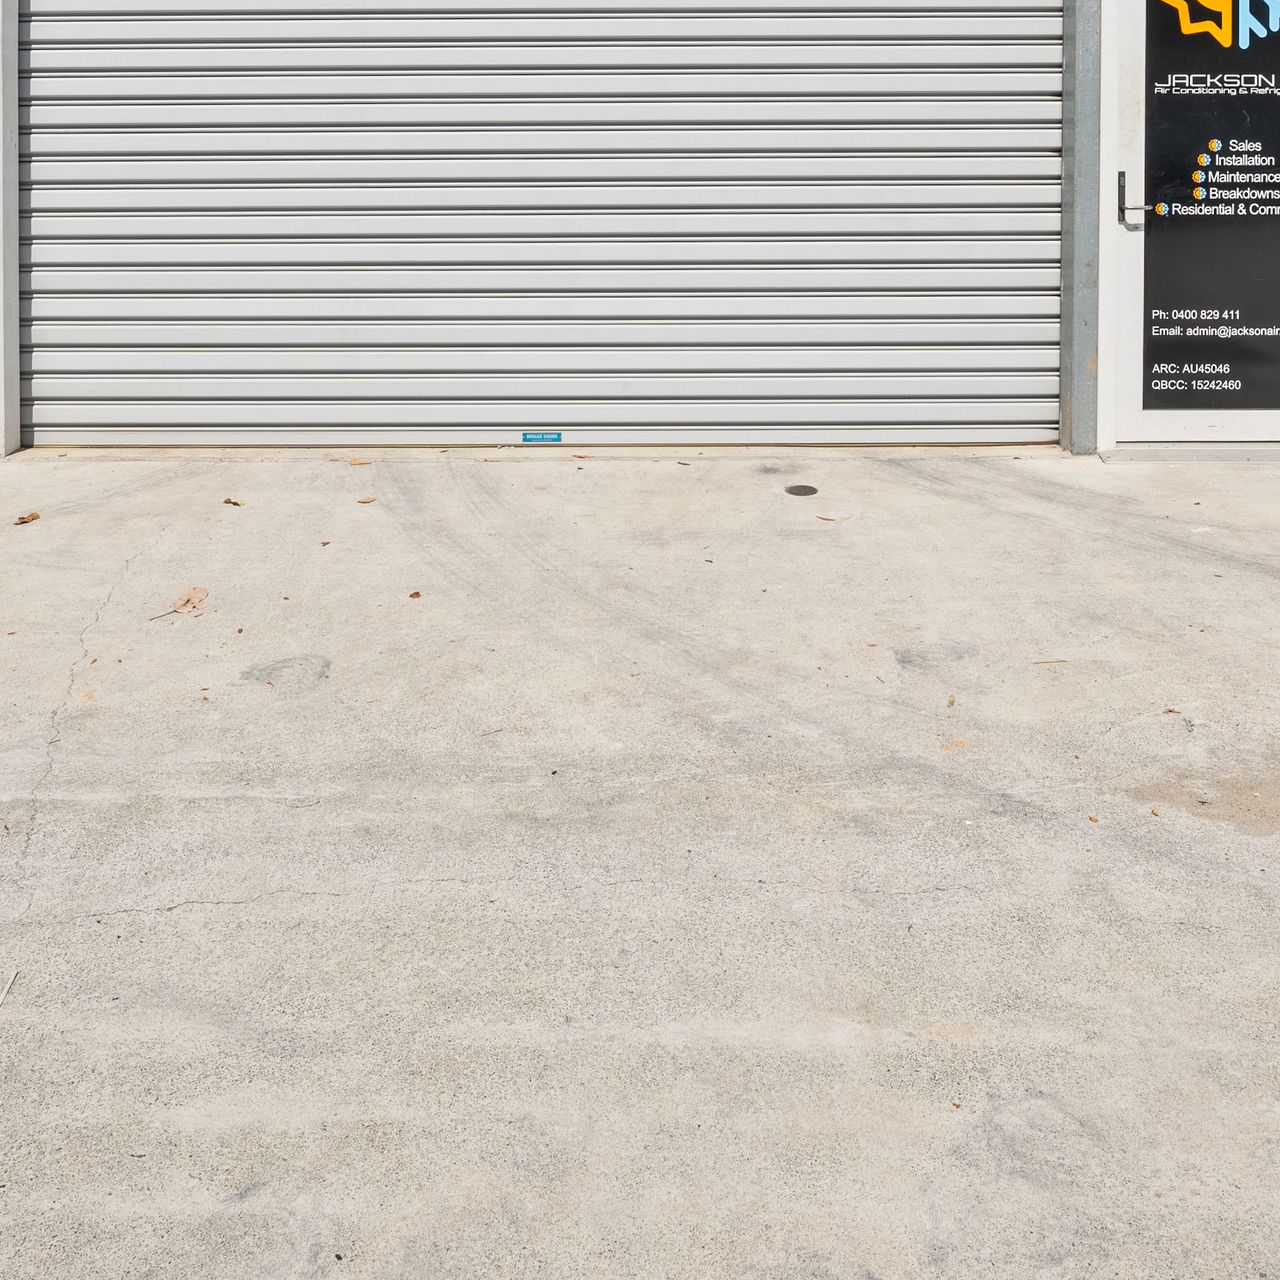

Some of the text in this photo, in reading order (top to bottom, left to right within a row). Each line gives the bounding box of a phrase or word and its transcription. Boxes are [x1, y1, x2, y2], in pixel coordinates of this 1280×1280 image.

[1154, 74, 1276, 87] JACKSON
[1154, 87, 1170, 95] Air
[1172, 87, 1237, 96] Conditioning
[1238, 87, 1249, 95] &
[1228, 139, 1263, 152] Sales
[1215, 154, 1276, 166] Installation
[1209, 187, 1280, 199] Breakdowns
[1171, 203, 1235, 215] Residential
[1237, 203, 1247, 215] &
[1151, 309, 1240, 320] Ph: 0400 829 411
[1151, 325, 1184, 336] Email:
[1151, 363, 1231, 374] ARC: AU45046
[1151, 379, 1242, 390] QBCC: 15242460
